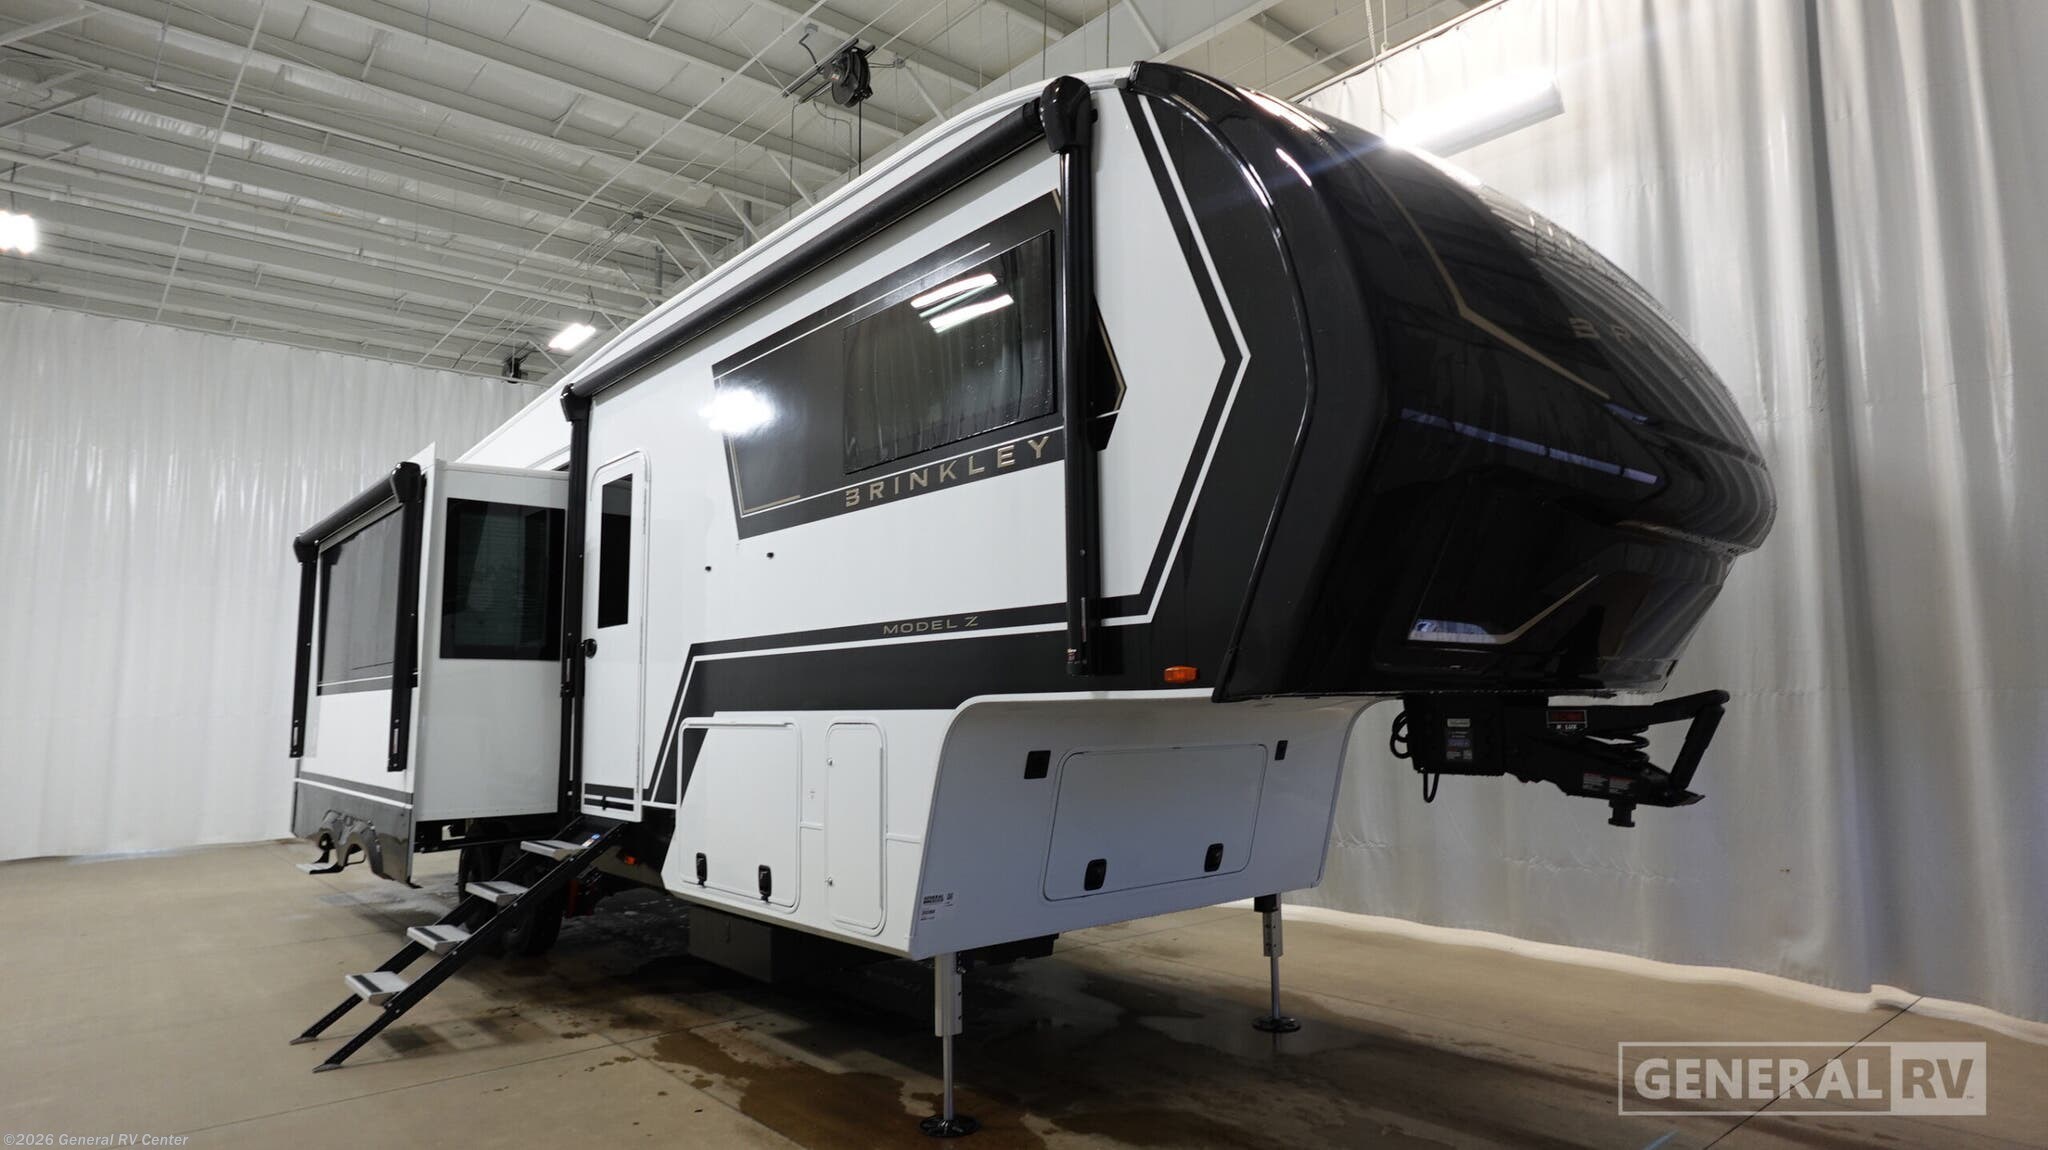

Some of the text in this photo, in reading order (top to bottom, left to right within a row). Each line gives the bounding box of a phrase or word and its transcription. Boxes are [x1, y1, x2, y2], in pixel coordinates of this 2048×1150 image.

[845, 436, 1049, 507] BRINKLEY
[883, 615, 979, 635] MODEL Z
